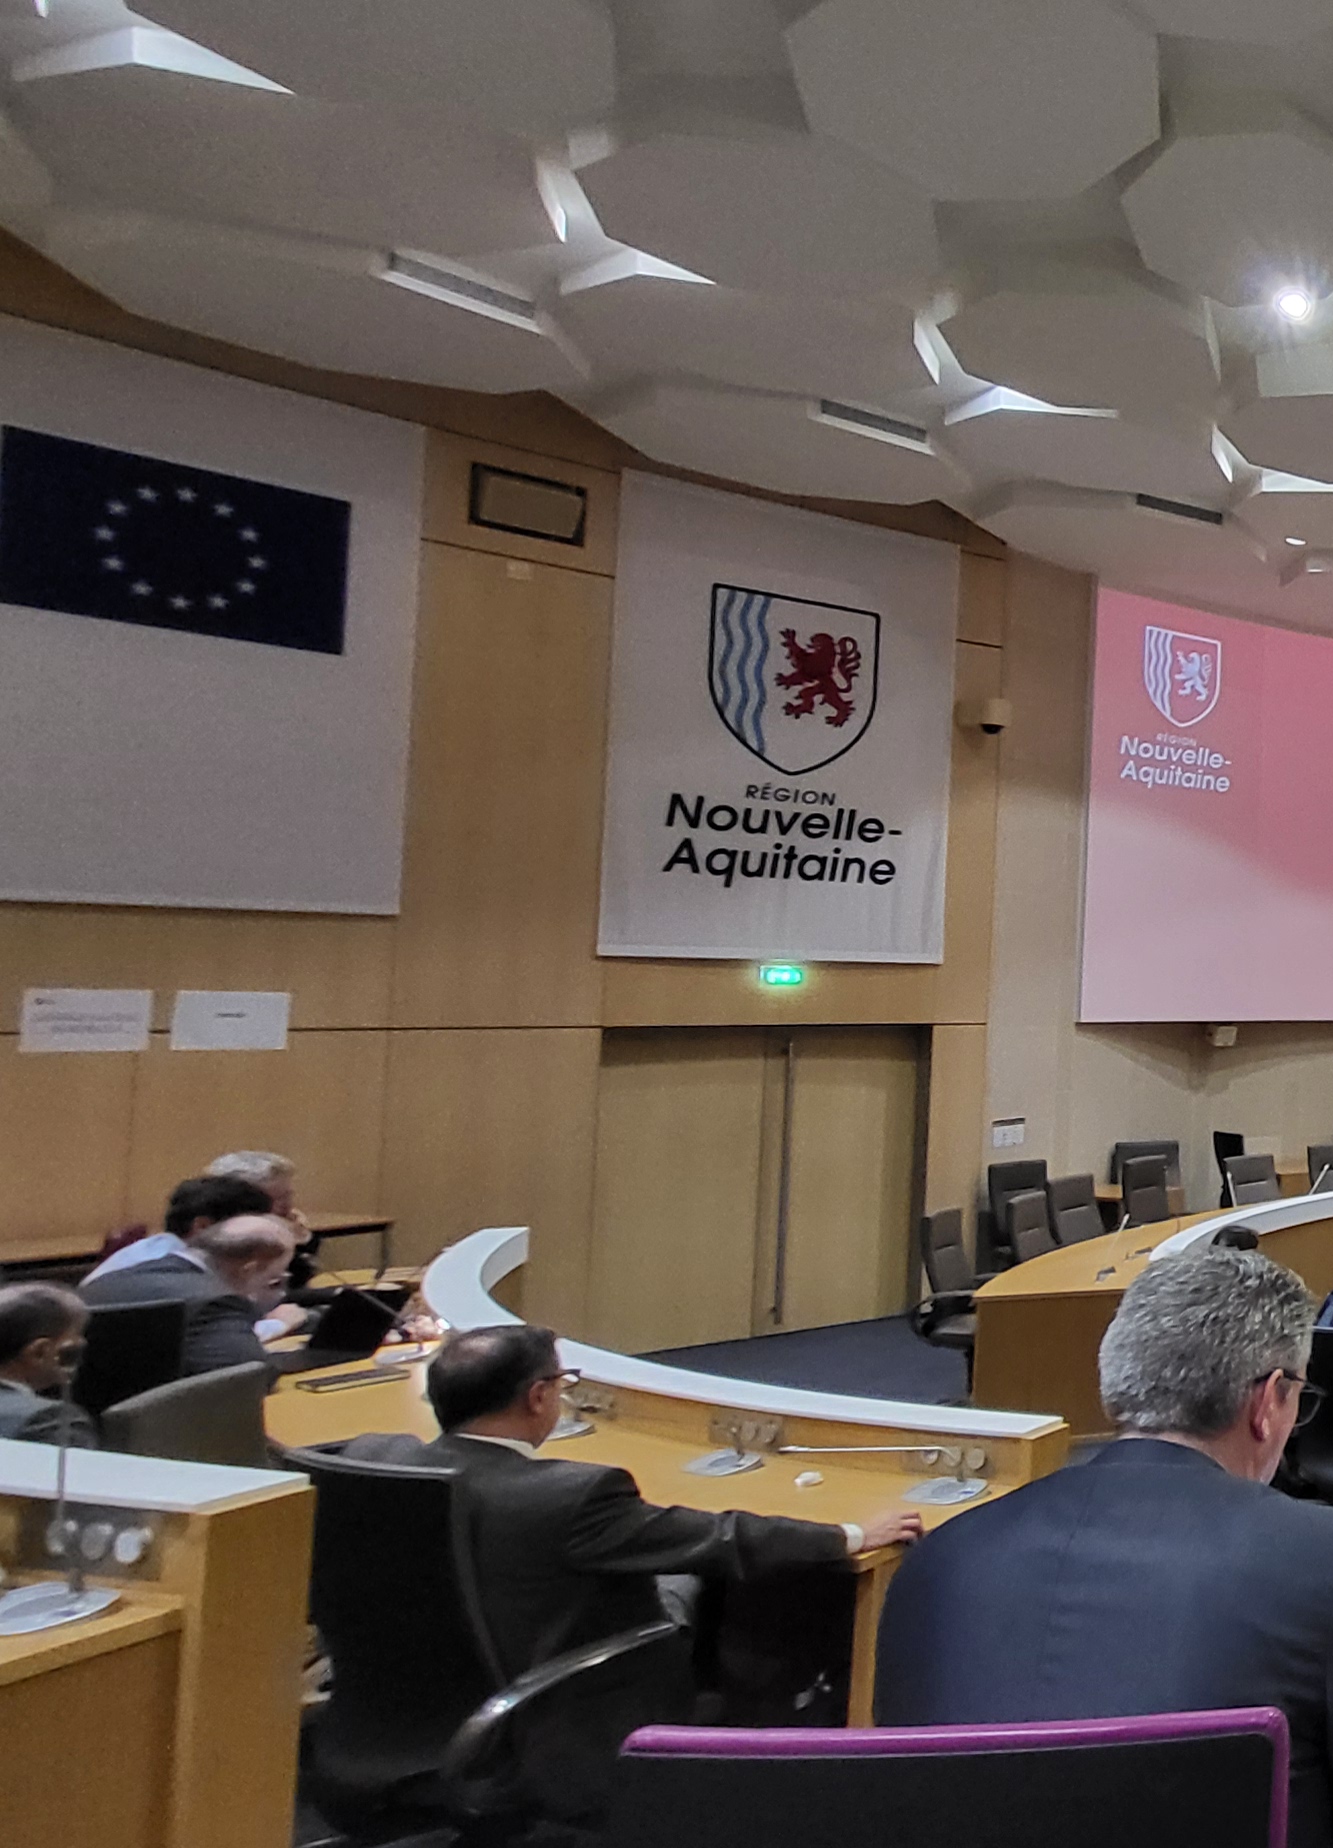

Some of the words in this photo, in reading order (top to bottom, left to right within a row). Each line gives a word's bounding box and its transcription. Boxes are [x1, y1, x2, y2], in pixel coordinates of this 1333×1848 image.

[1120, 735, 1232, 769] Nouvelle-
[1120, 760, 1230, 792] Aquitaine
[745, 783, 835, 806] RÉGION
[665, 793, 902, 843] Nouvelle-
[662, 837, 896, 888] Aquitaine
